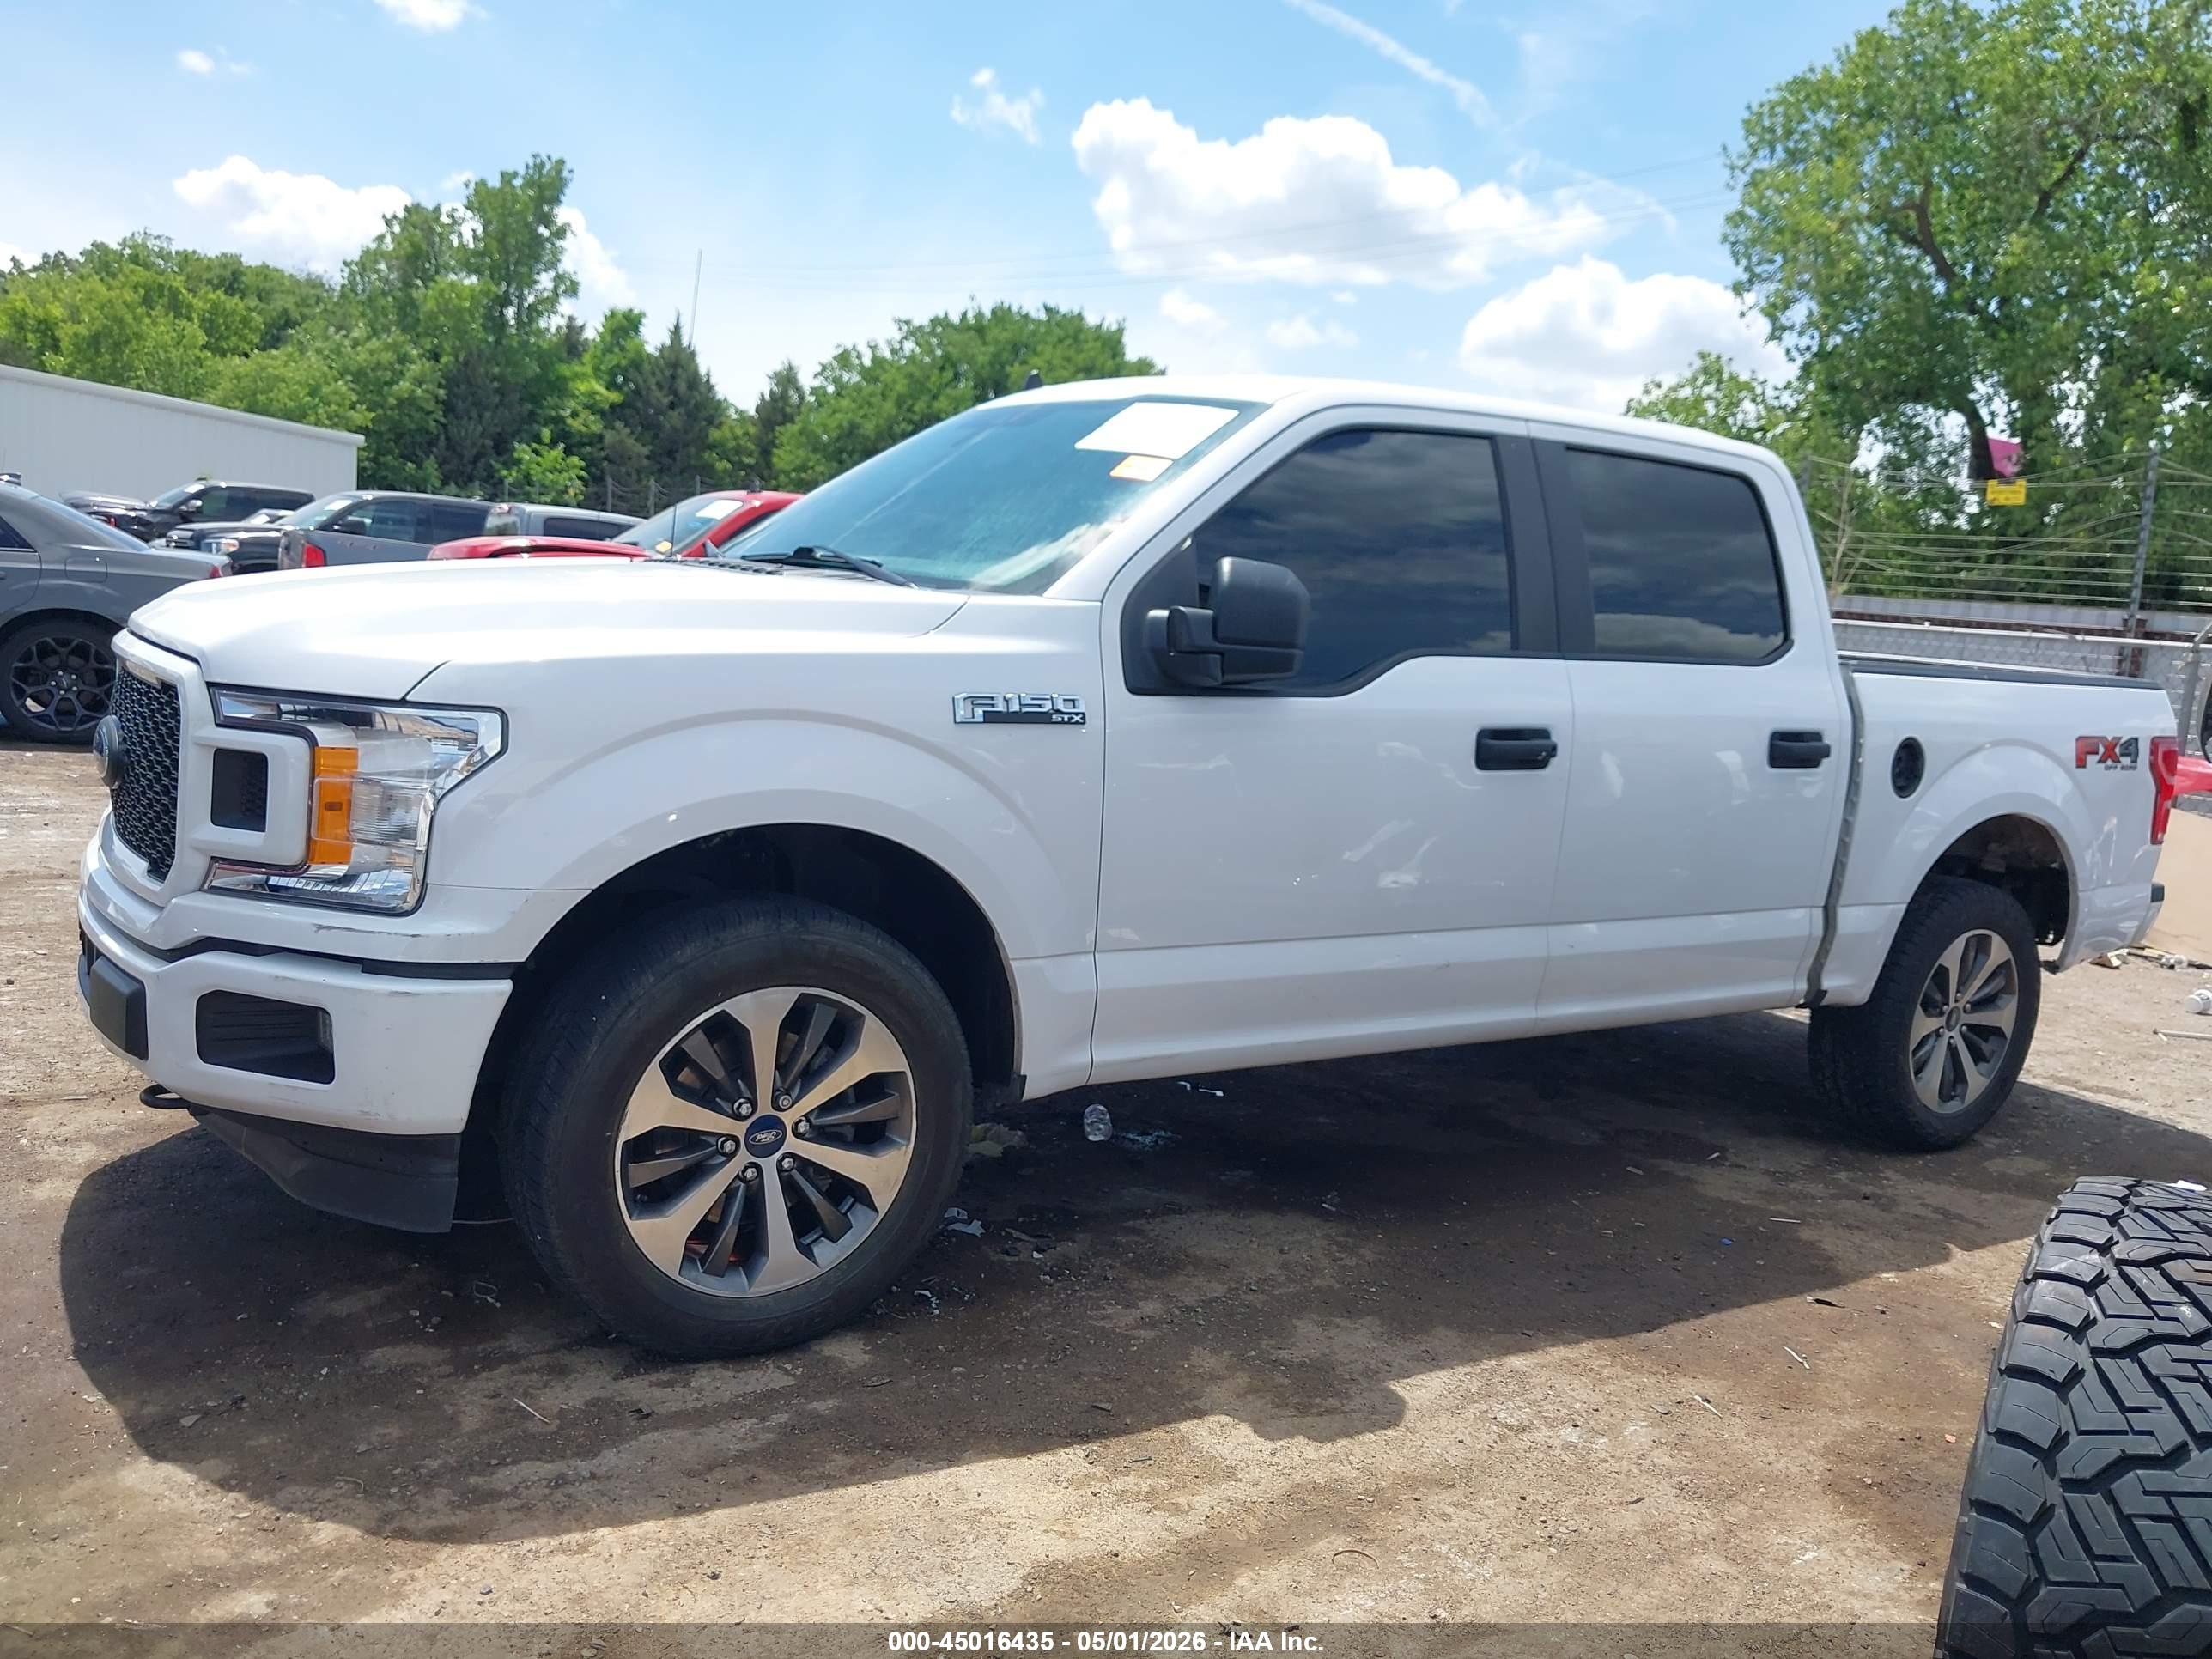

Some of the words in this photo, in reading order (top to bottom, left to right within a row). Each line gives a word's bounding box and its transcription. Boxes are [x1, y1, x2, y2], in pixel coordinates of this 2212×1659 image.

[953, 693, 1085, 722] F150
[1051, 714, 1084, 723] STX
[2075, 736, 2139, 768] FX4
